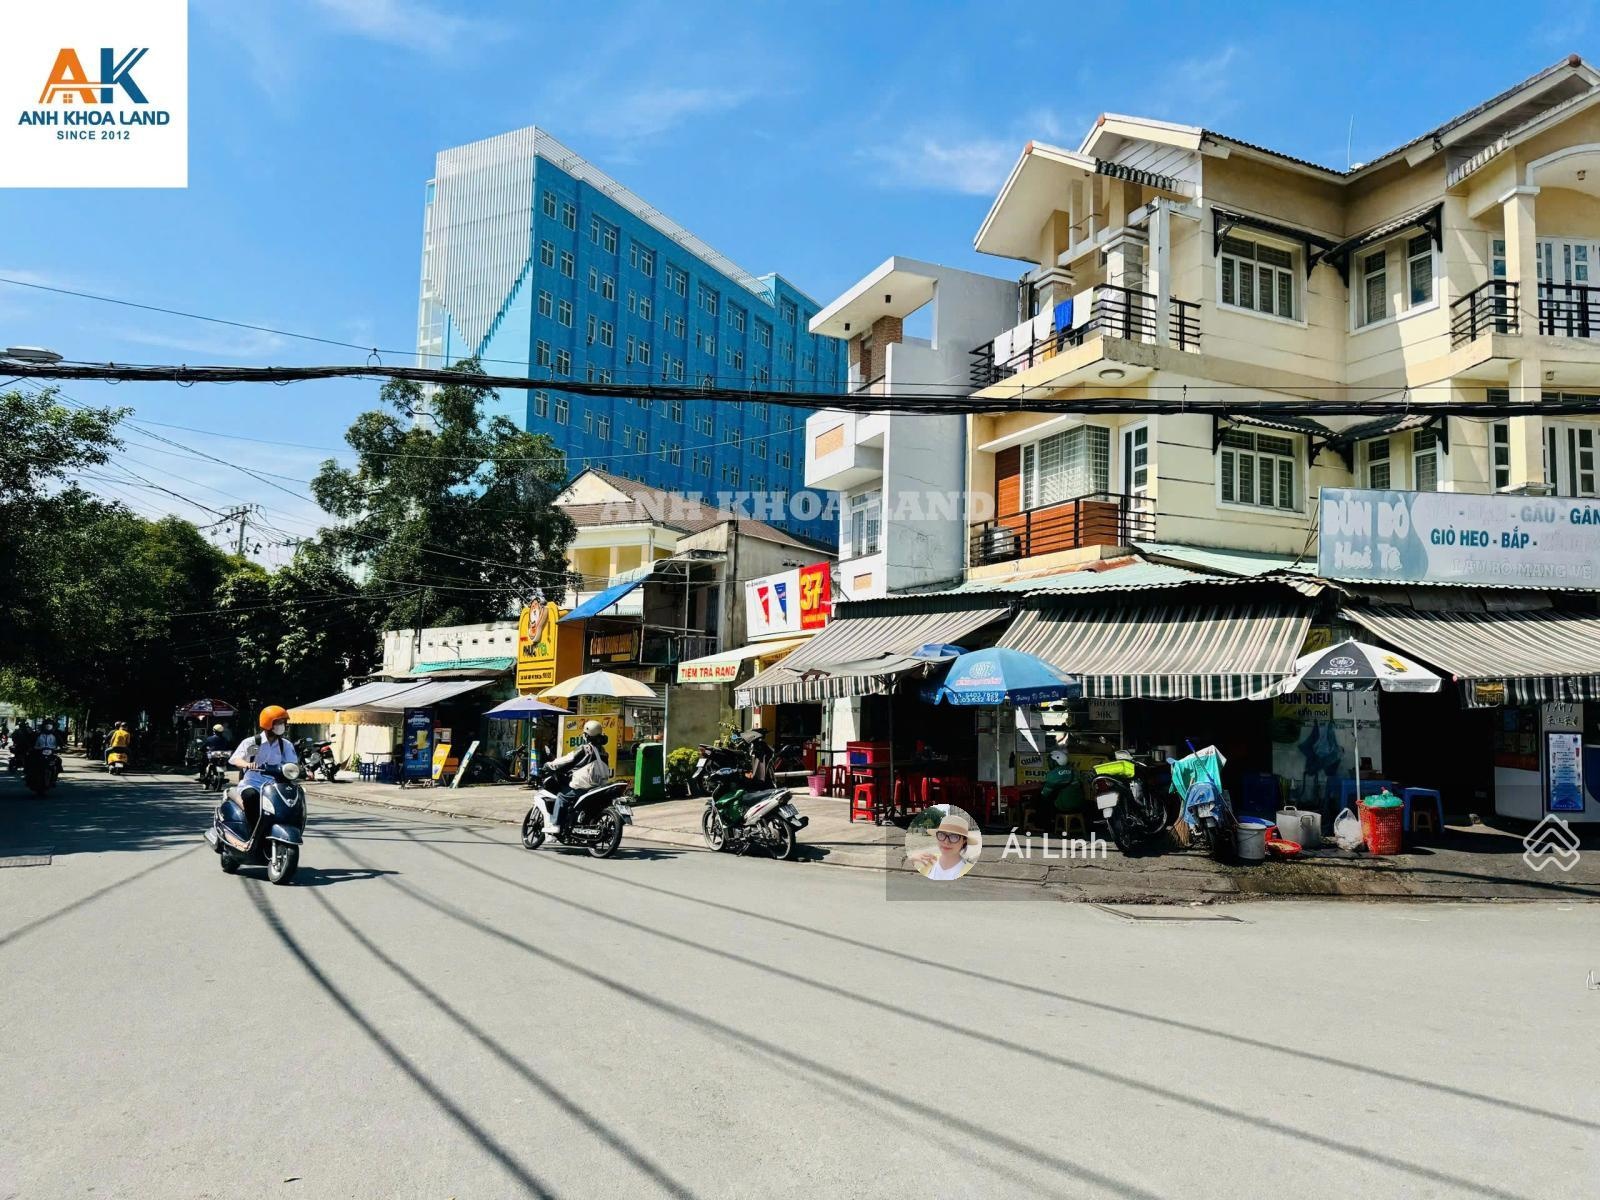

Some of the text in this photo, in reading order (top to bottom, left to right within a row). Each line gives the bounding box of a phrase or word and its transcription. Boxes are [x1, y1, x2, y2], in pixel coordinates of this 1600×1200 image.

[1430, 524, 1456, 546] GIÒ
[1459, 530, 1489, 547] HEO
[1501, 525, 1530, 549] BẮP
[1320, 668, 1359, 676] Legend
